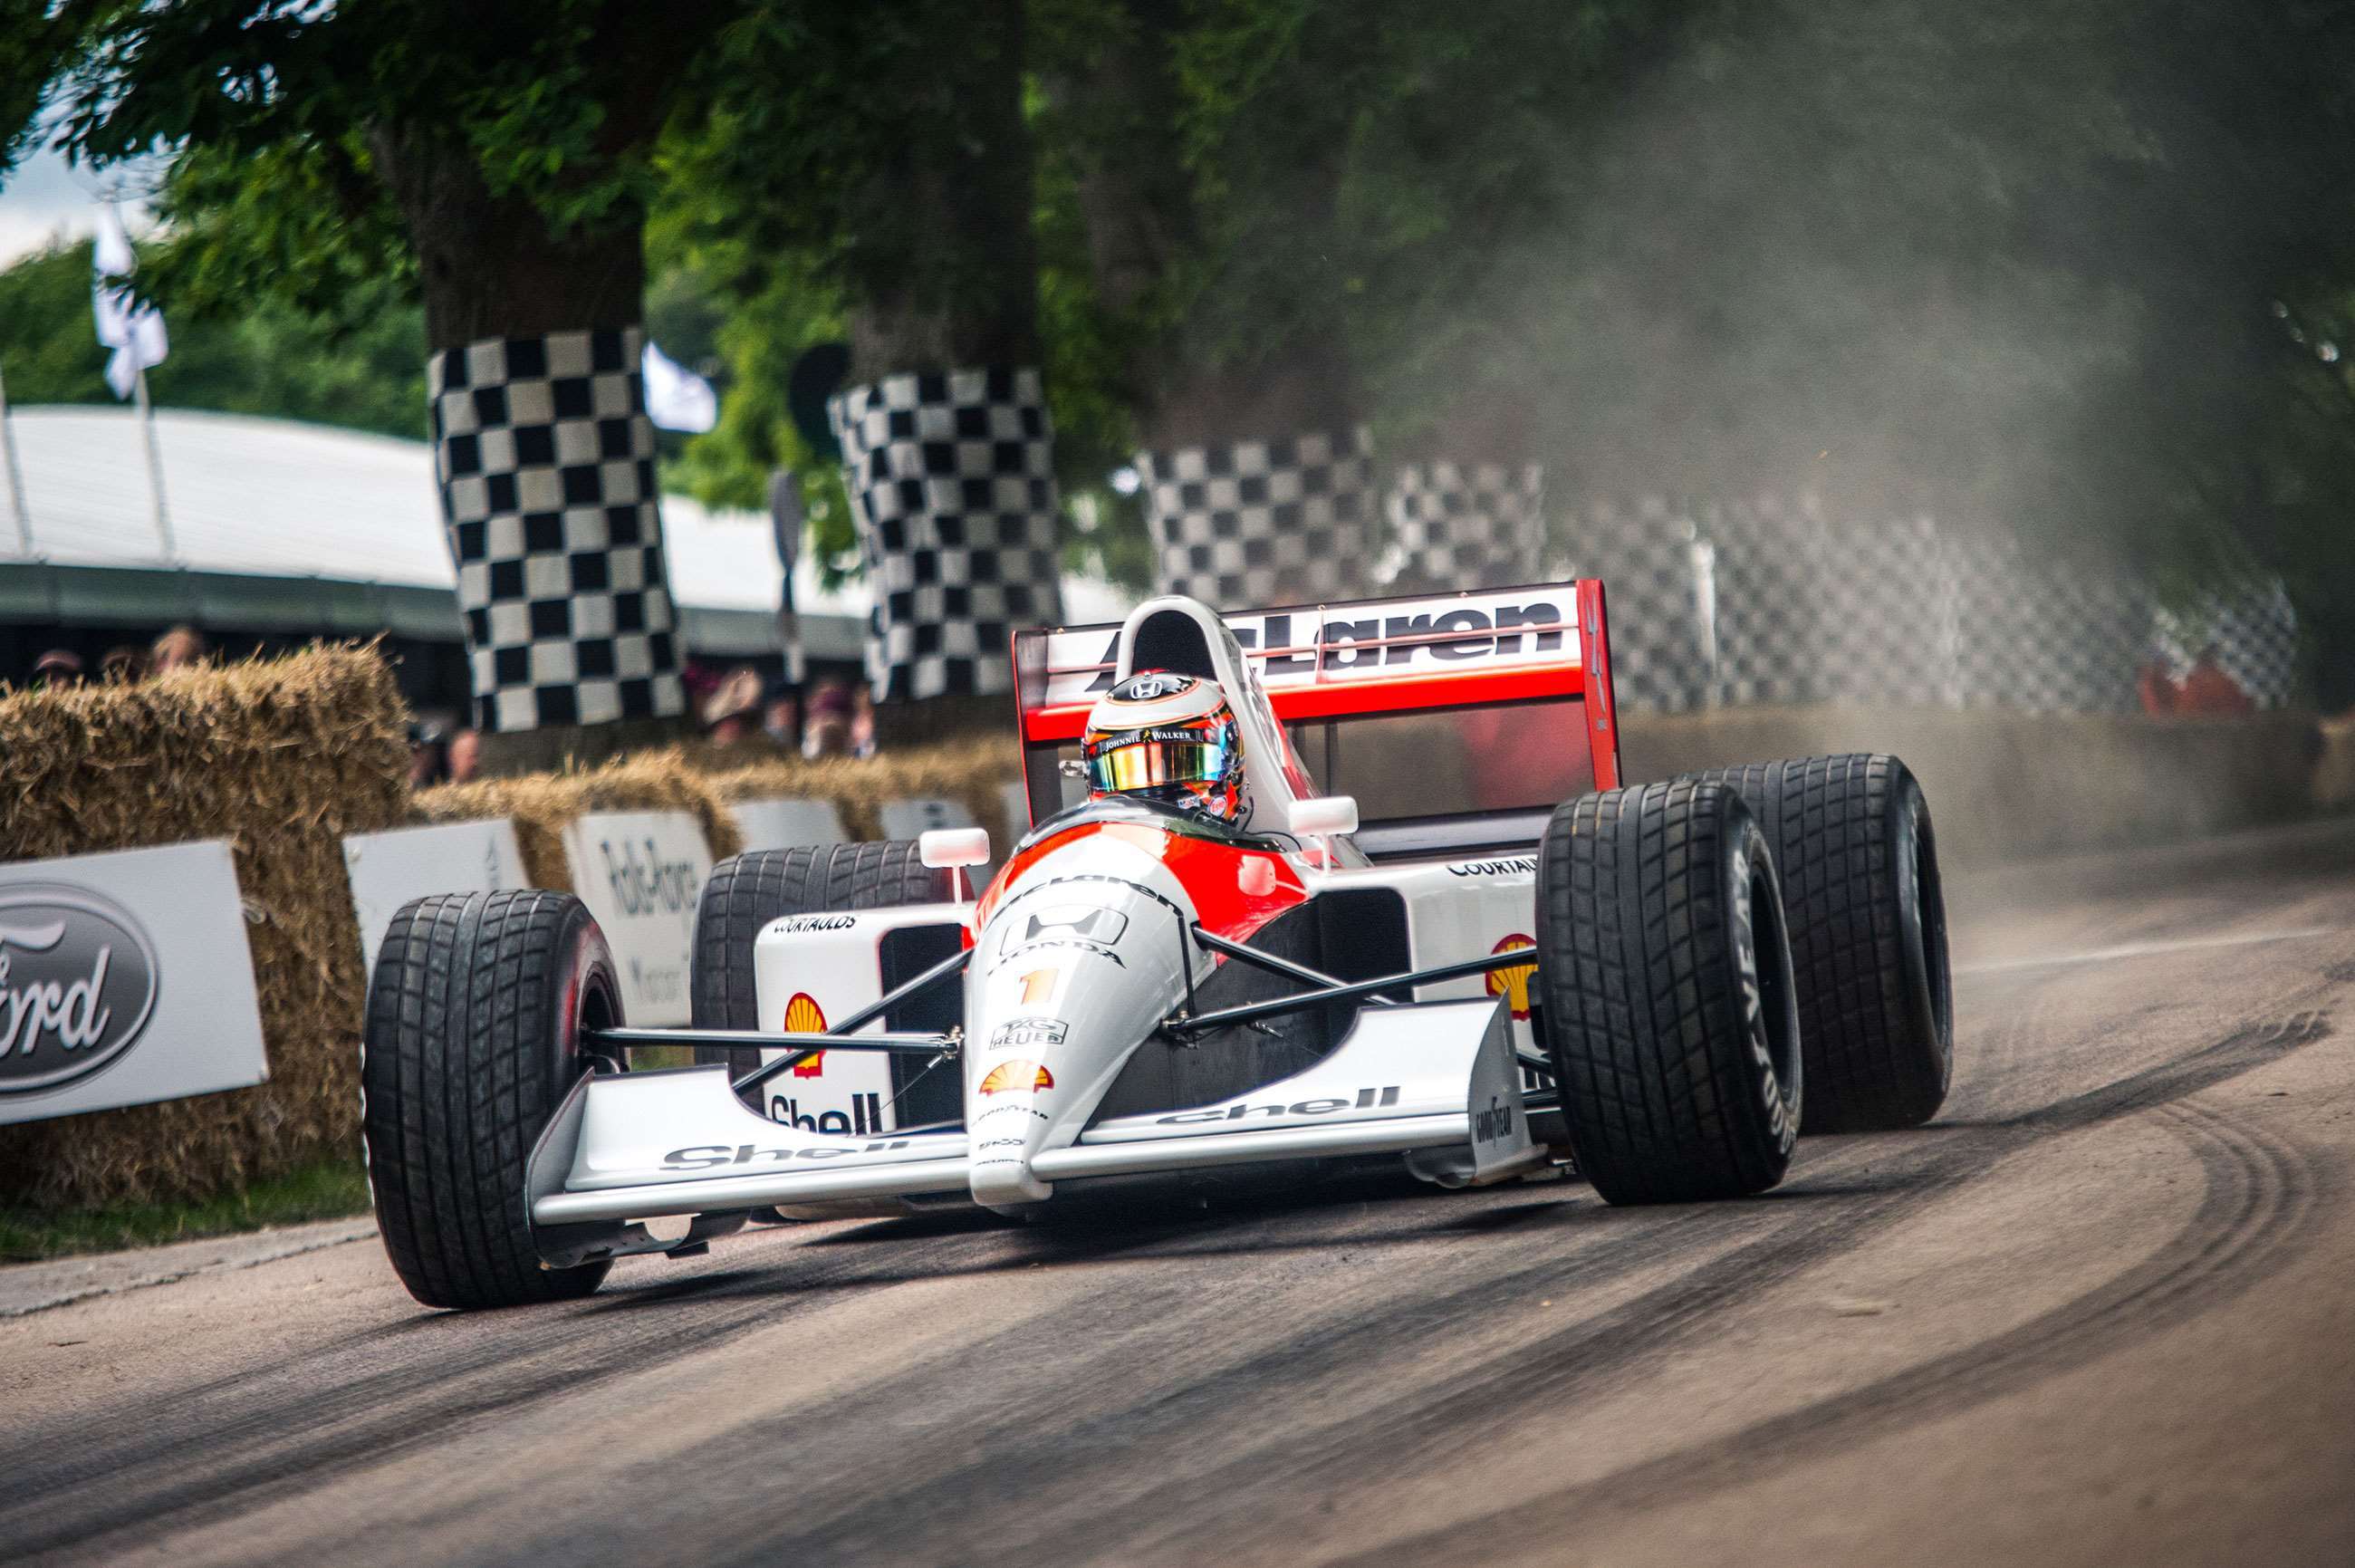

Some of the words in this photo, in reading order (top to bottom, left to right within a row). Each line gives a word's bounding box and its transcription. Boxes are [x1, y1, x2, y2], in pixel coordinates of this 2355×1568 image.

[1083, 601, 1563, 691] Laren
[1104, 735, 1141, 753] JOHNNIE
[1151, 731, 1191, 741] WALKER
[987, 940, 1127, 977] HONDA
[1019, 968, 1060, 1005] 1
[771, 1092, 885, 1136] Shell
[658, 1140, 910, 1170] Shell
